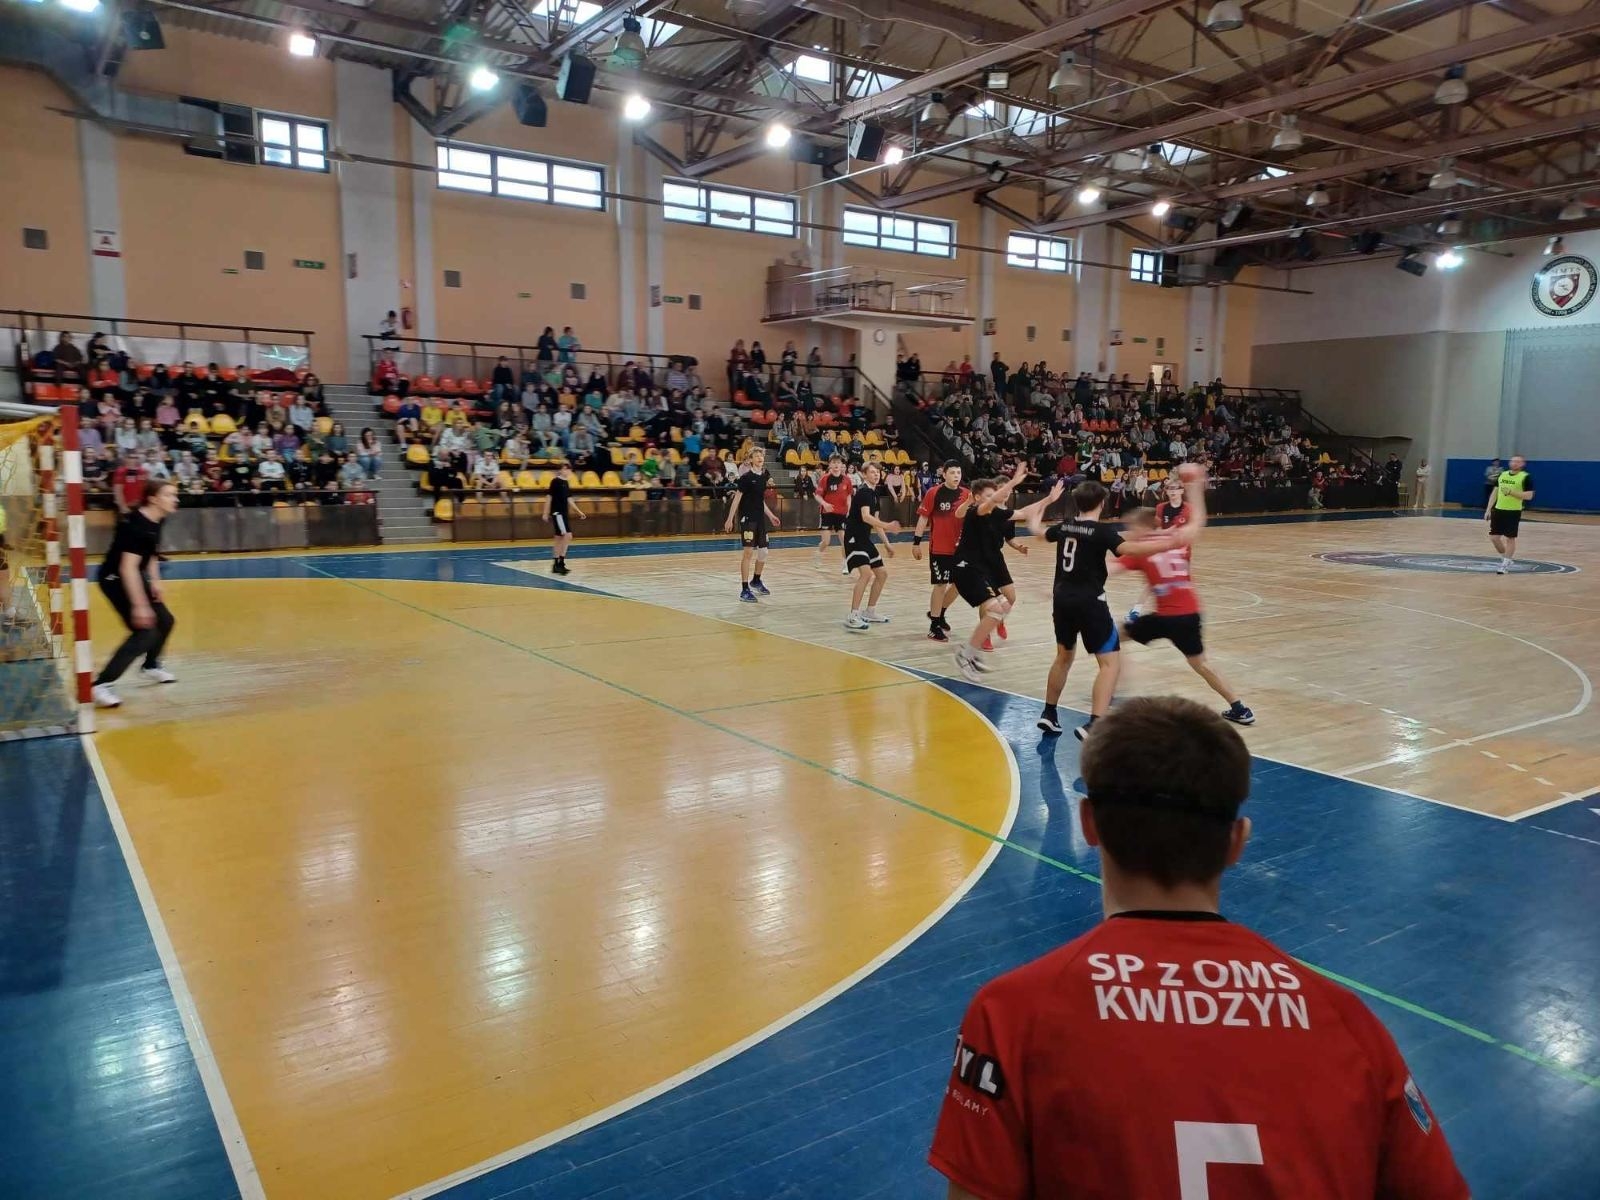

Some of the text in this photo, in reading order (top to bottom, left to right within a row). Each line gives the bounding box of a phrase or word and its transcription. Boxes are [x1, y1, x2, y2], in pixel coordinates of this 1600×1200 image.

[940, 502, 951, 511] 99
[1062, 537, 1078, 573] 9
[1087, 953, 1301, 990] SP z OMS
[1094, 985, 1310, 1030] KWIDZYN
